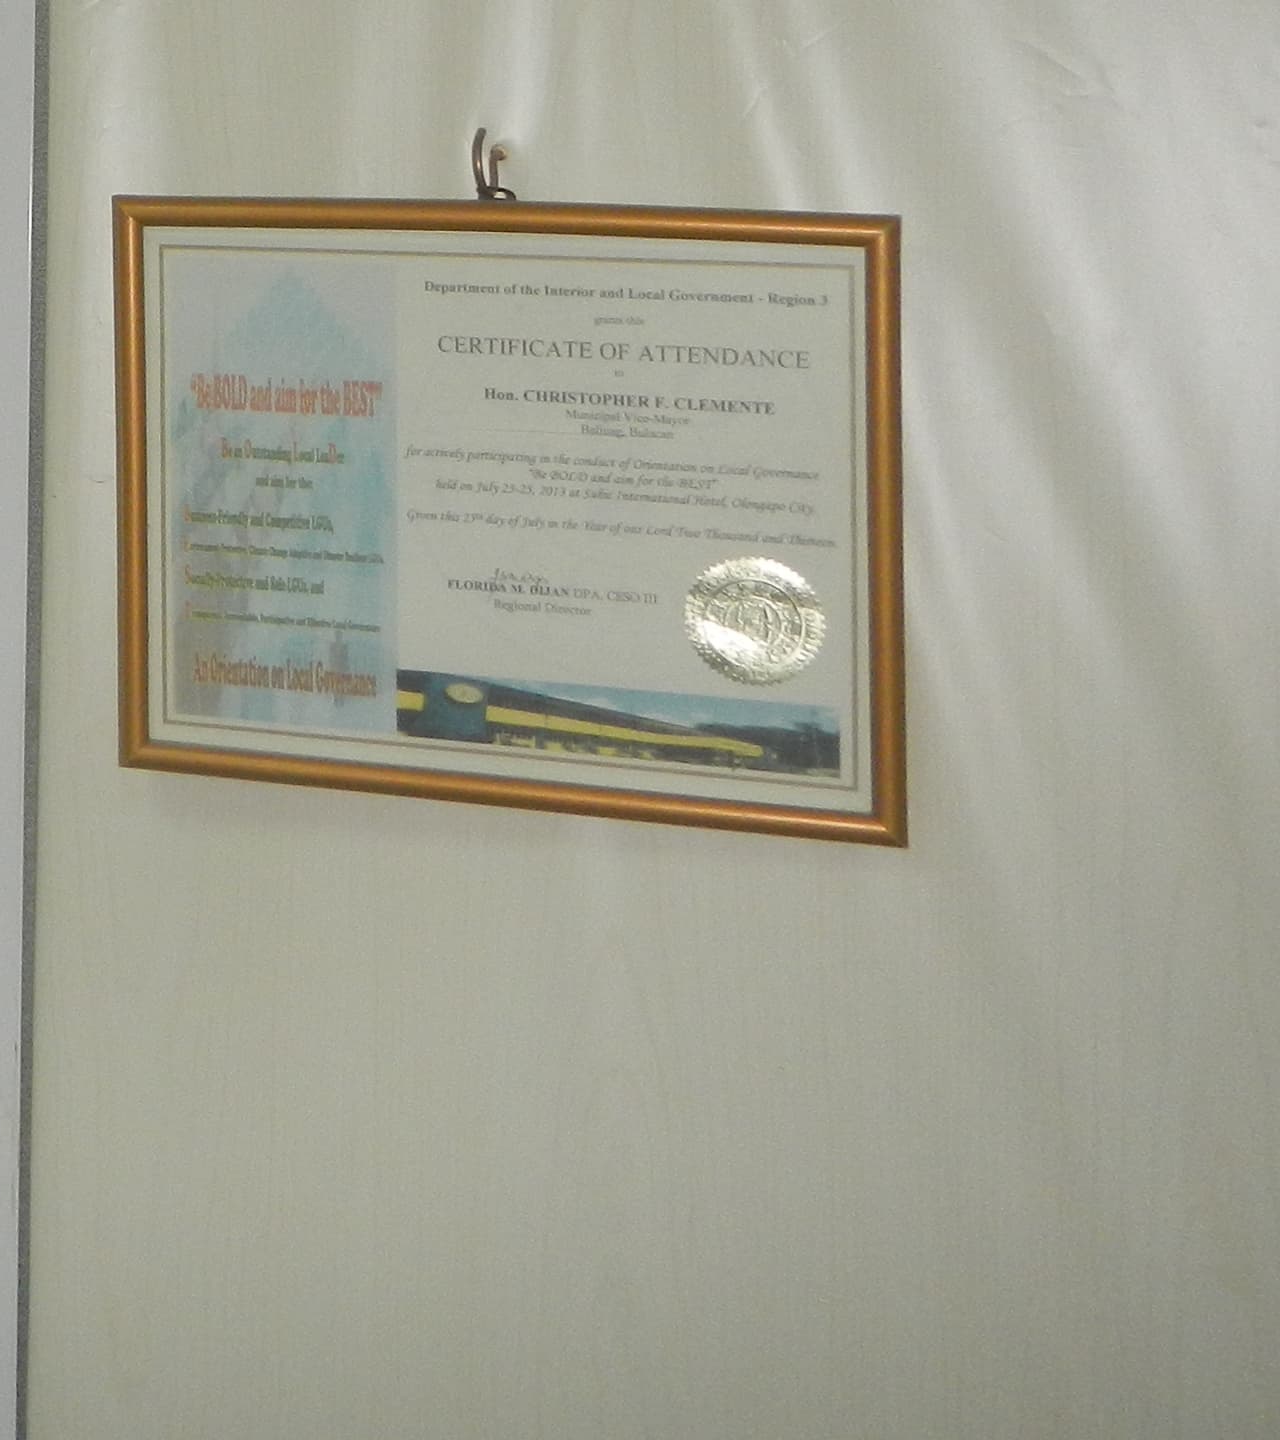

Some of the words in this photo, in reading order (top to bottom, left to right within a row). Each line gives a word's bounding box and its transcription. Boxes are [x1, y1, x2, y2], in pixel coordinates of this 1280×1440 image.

[424, 281, 500, 296] Department
[503, 284, 517, 296] of
[520, 285, 540, 297] the
[544, 286, 594, 299] Interior
[599, 288, 624, 300] and
[628, 288, 666, 301] Local
[668, 289, 755, 304] Government
[767, 292, 816, 308] Region
[820, 294, 829, 307] 3
[438, 335, 593, 360] CERTIFICATE
[599, 342, 631, 361] OF
[639, 345, 811, 369] ATTENDANCE
[484, 387, 519, 402] Hon.
[523, 389, 650, 409] CHRISTOPHER
[673, 397, 777, 416] CLEMENTE
[447, 579, 508, 594] FLORIDA
[493, 599, 541, 613] Regional
[545, 603, 592, 616] Director
